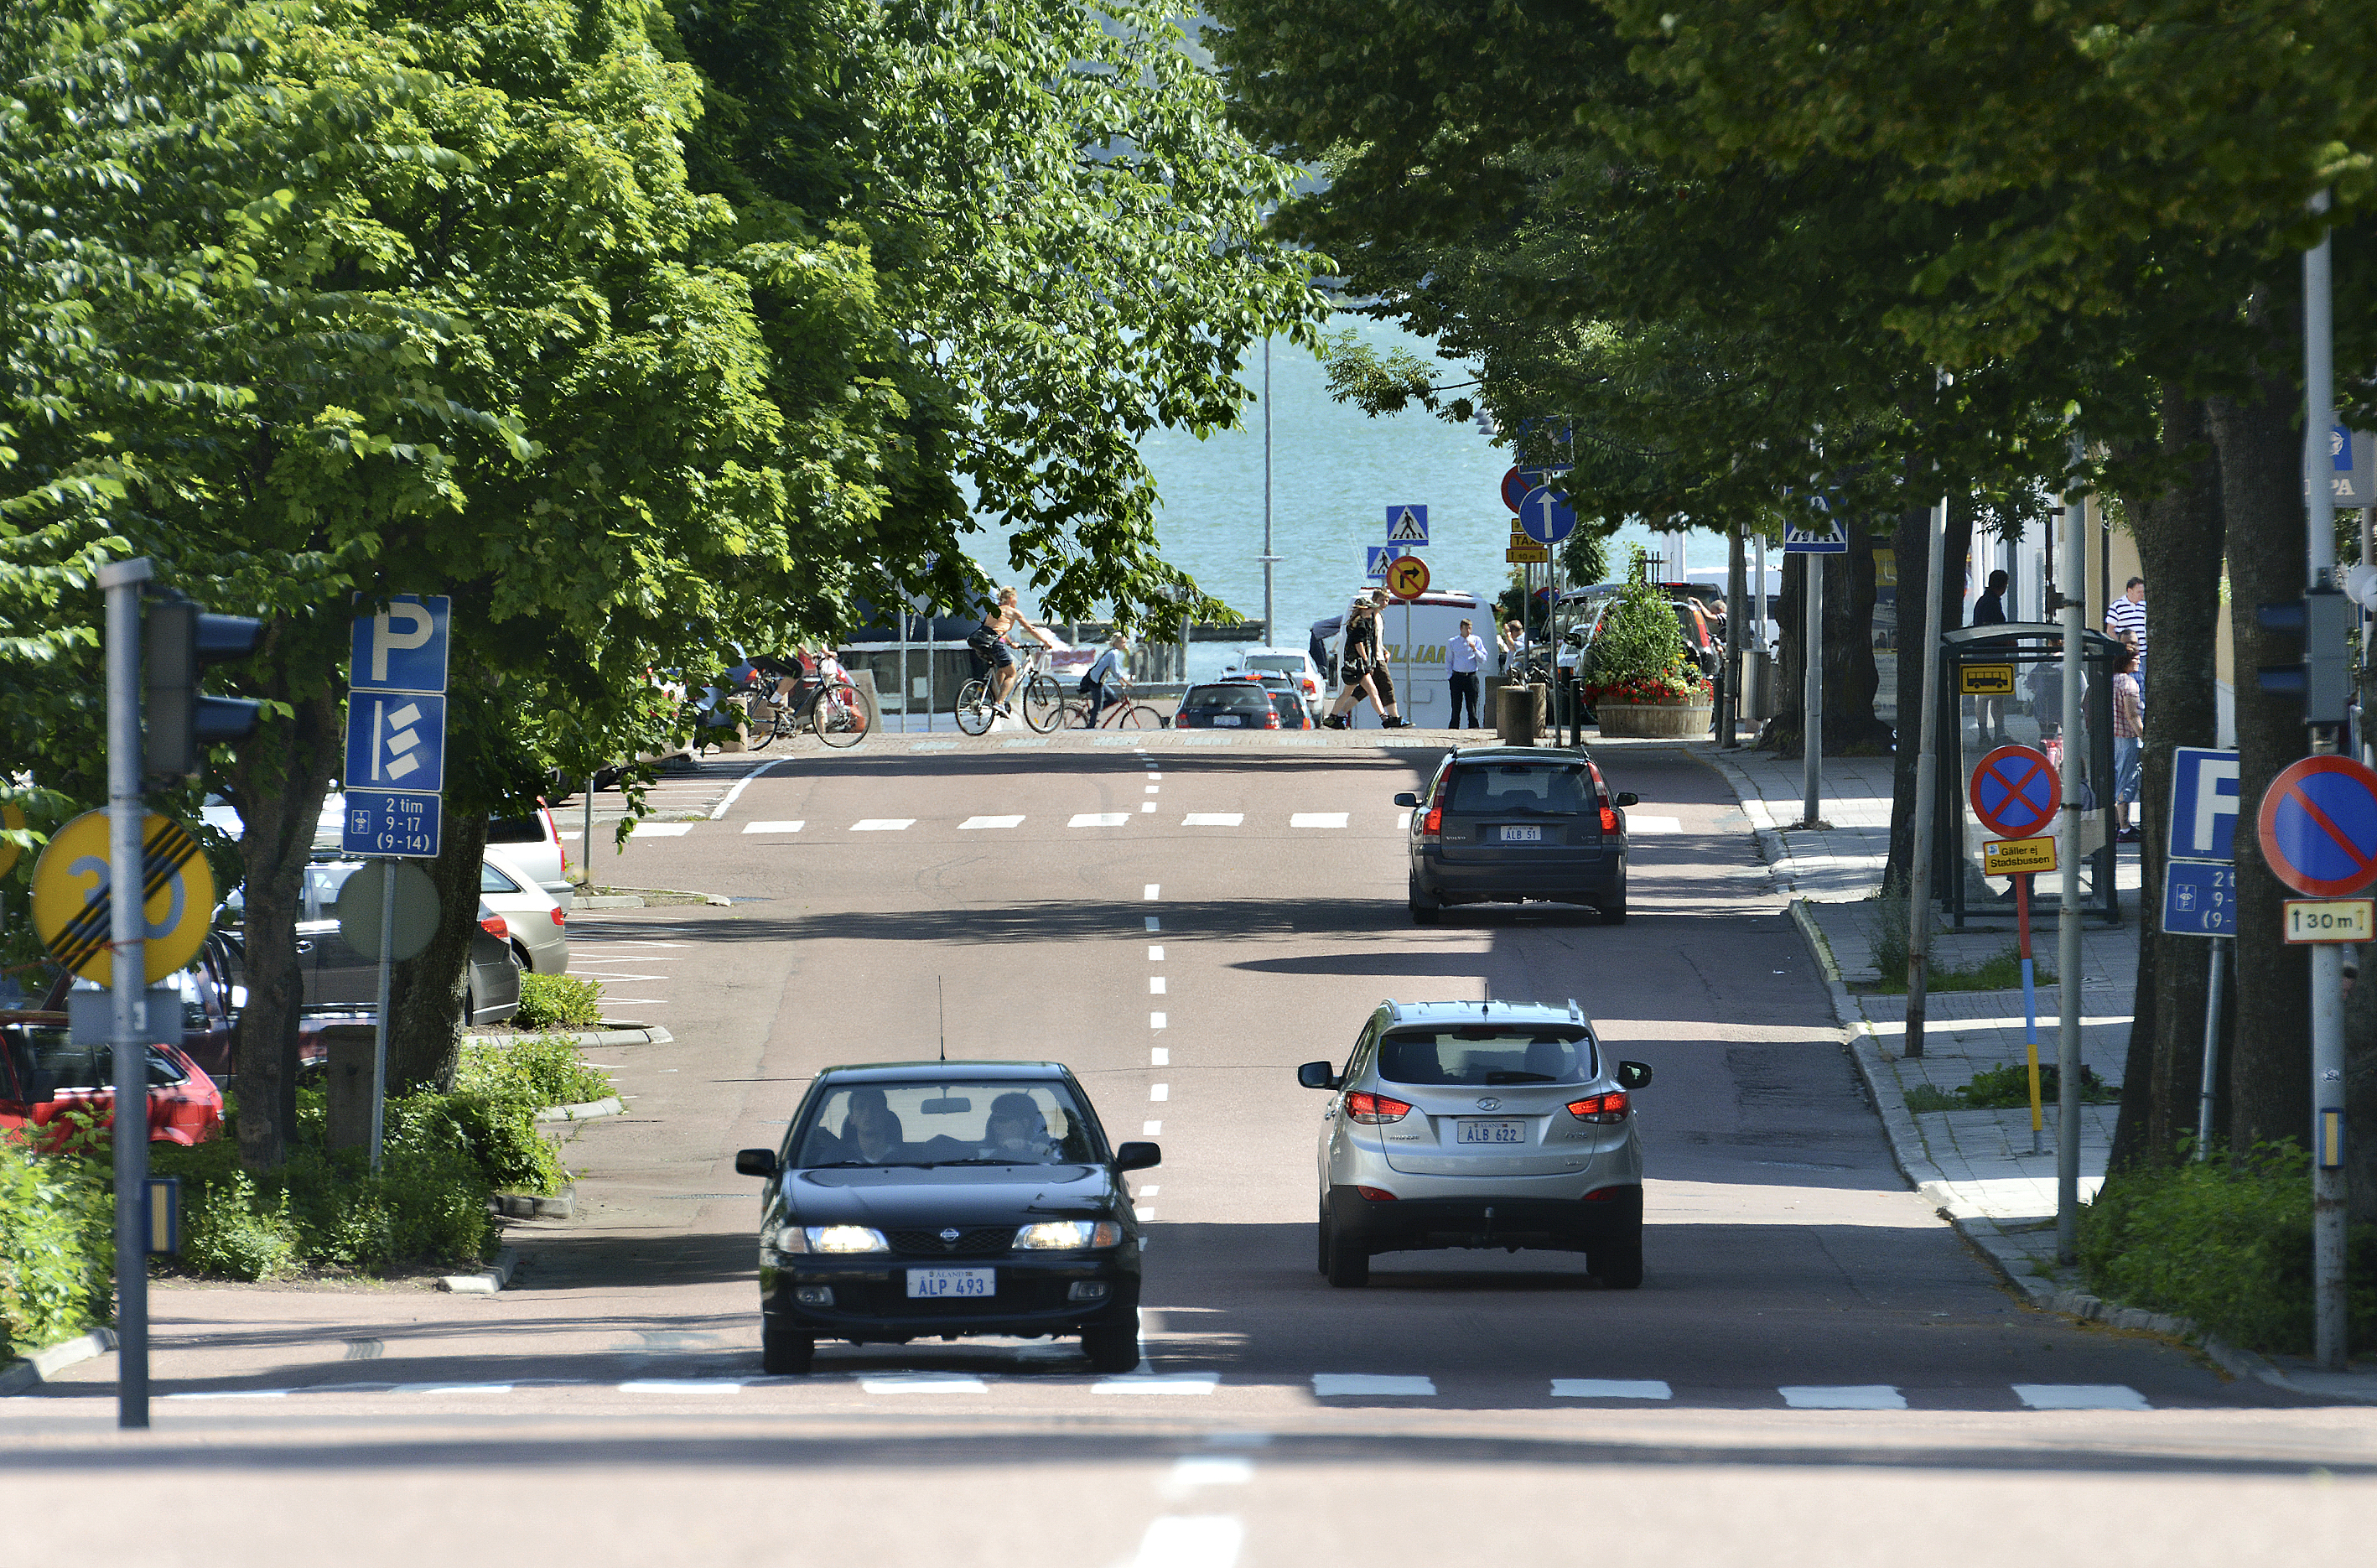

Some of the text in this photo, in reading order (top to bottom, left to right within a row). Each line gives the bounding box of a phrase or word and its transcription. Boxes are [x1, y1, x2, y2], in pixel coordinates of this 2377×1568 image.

[371, 601, 433, 681] P
[387, 797, 423, 813] 2 tim
[387, 816, 421, 832] 9-17
[376, 832, 430, 852] (9-14)
[1527, 830, 1536, 839] 51
[2001, 845, 2038, 856] Gäller ej
[1990, 856, 2050, 868] Stadsbussen
[2213, 871, 2224, 887] 2
[2307, 913, 2353, 929] 30 m
[1467, 1125, 1517, 1141] ÅLB 622
[918, 1275, 984, 1295] ÅLP 493
